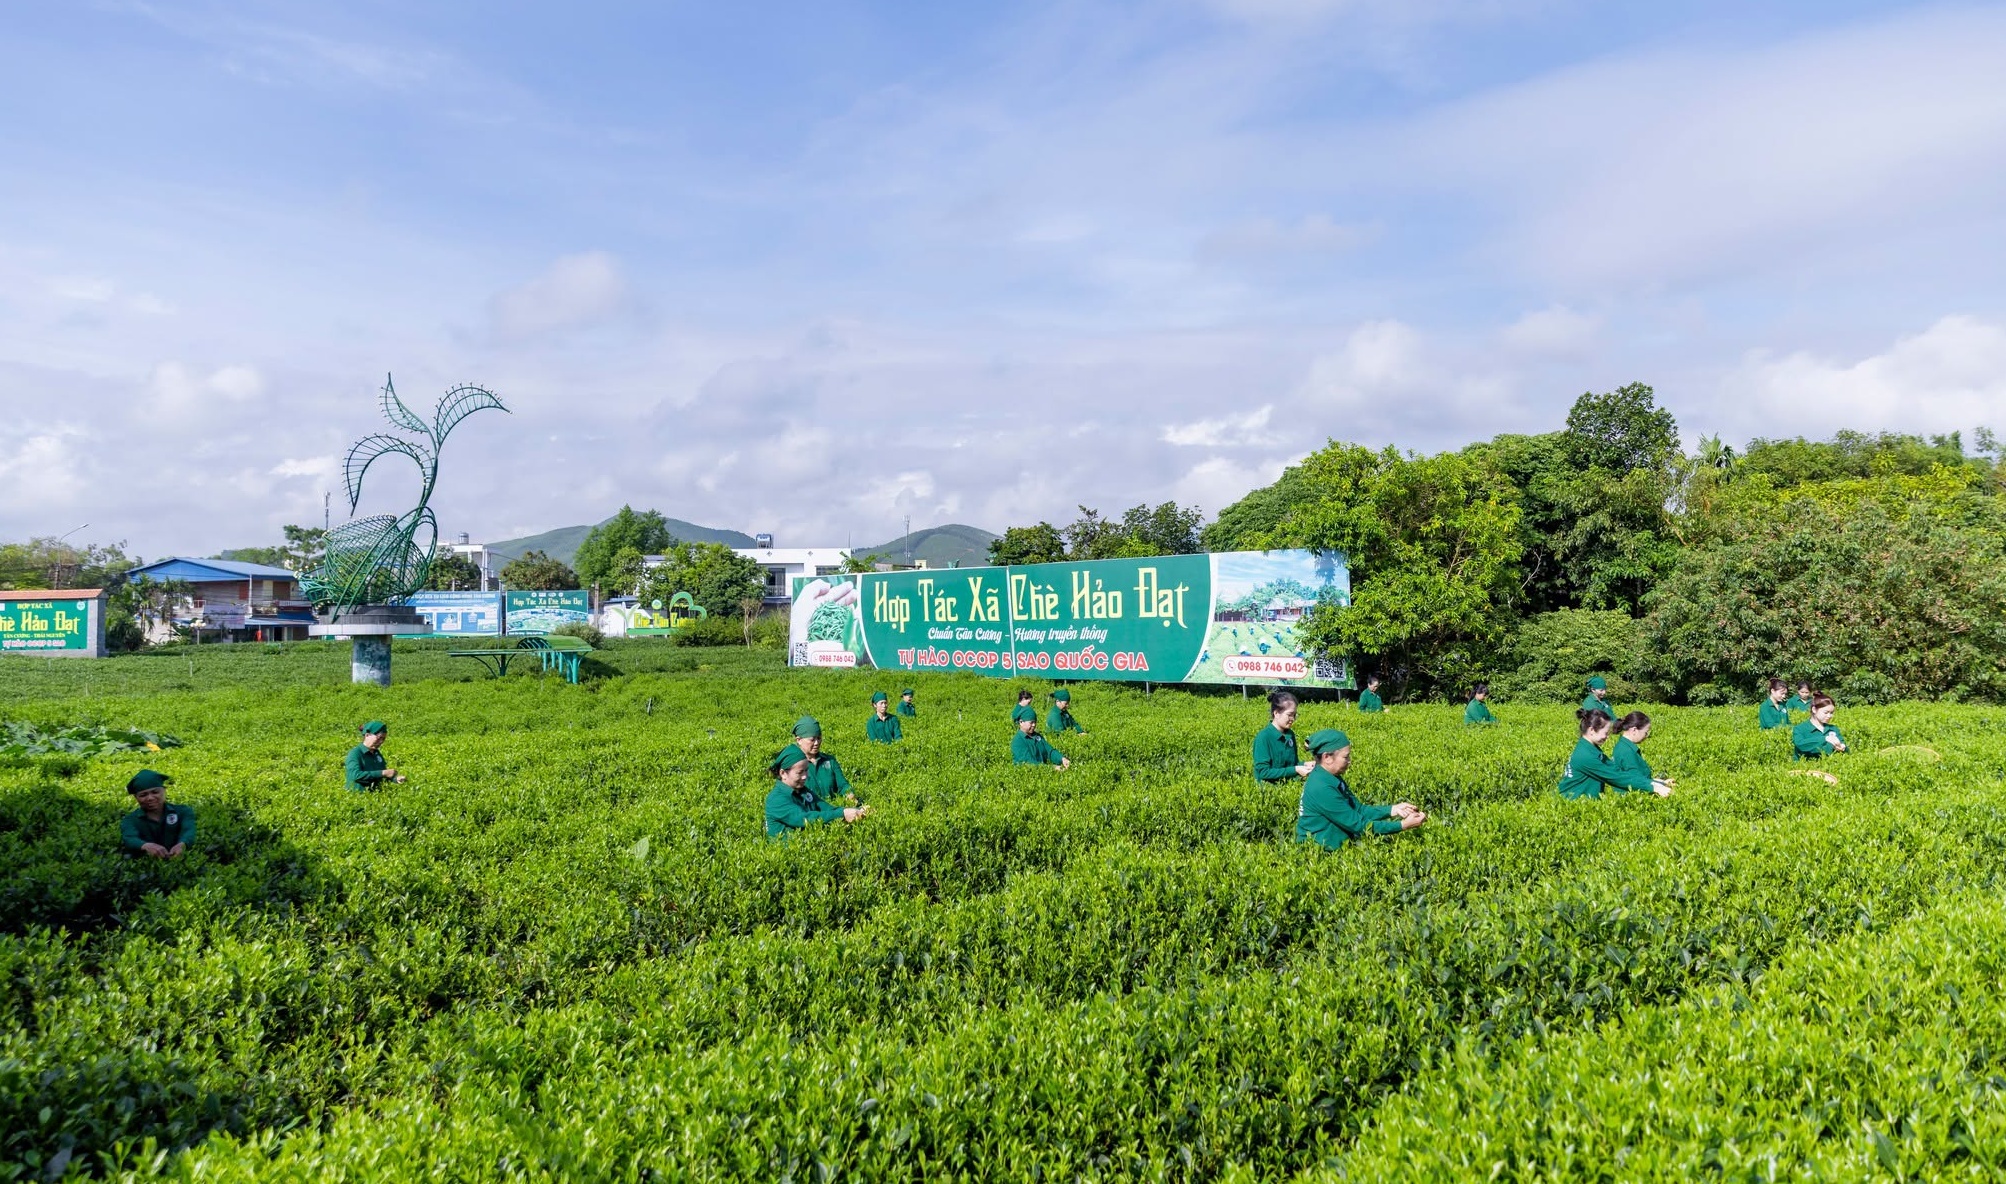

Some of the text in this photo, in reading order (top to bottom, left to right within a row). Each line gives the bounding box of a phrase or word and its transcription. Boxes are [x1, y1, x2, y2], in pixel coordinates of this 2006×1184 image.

[874, 567, 1190, 633] Hợp Tác Xã Chè Hảo Đạt
[0, 611, 81, 635] hè Hảo Đạt
[928, 625, 953, 640] Chuẩn
[955, 627, 973, 640] Tân
[975, 628, 1002, 644] Cương
[1015, 628, 1046, 644] Hương
[1048, 625, 1077, 643] truyền
[1080, 624, 1108, 643] thống
[898, 644, 1149, 671] TỰ HÀO OCOP 5 SAO QUỐC GIA
[1237, 661, 1304, 673] 0988 746 042
